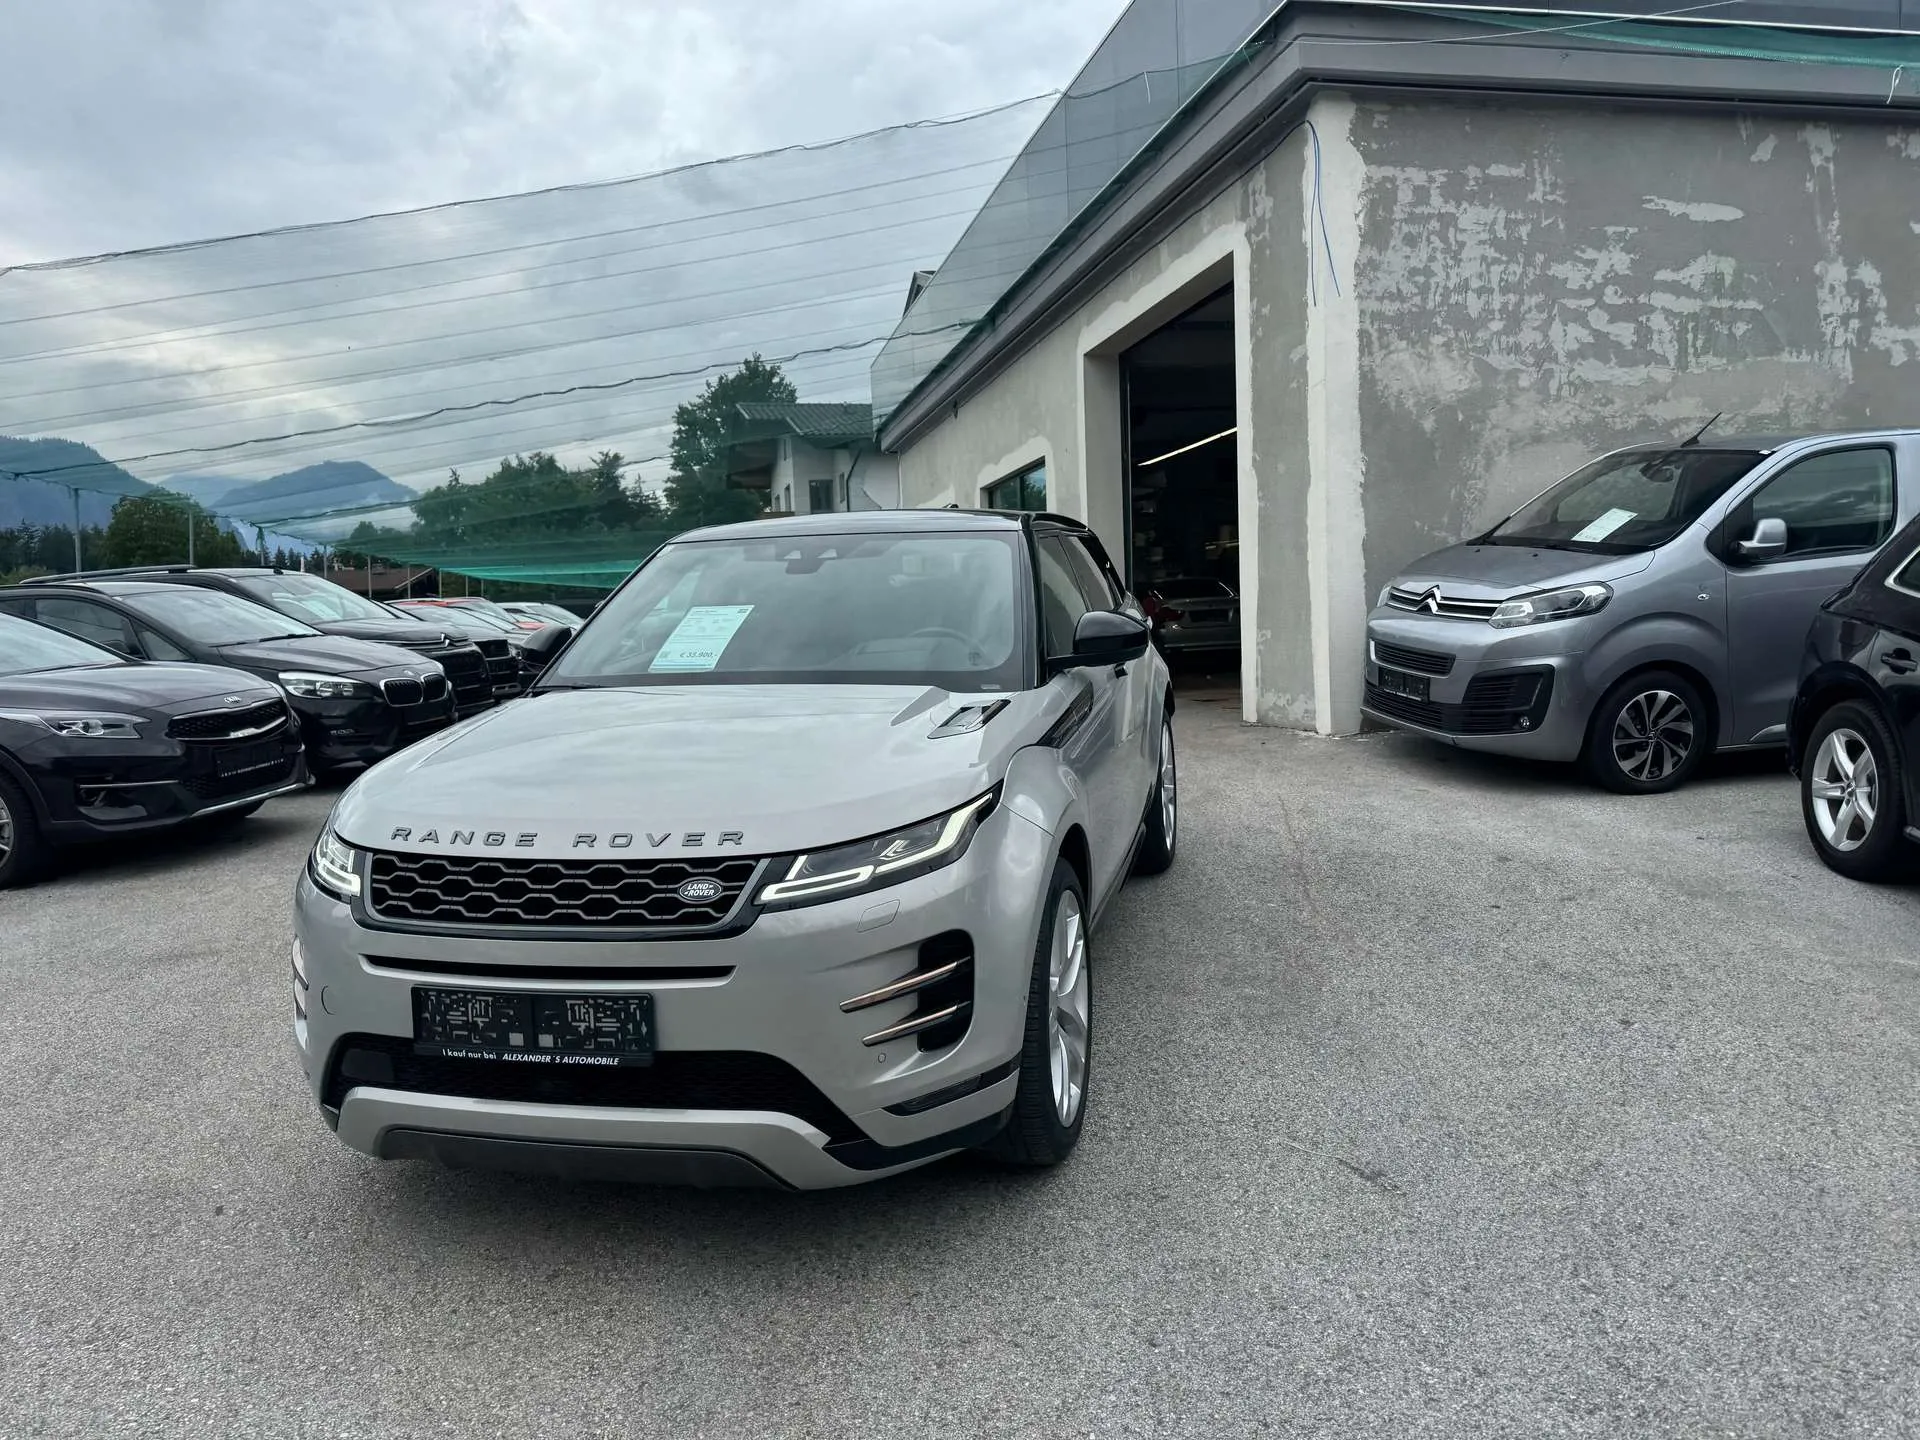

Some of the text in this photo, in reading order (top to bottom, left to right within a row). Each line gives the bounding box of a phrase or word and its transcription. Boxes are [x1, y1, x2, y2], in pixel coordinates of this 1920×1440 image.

[391, 826, 744, 848] RANGE ROVER
[687, 889, 715, 897] ROVER
[447, 1048, 466, 1058] kauf
[483, 1051, 497, 1060] bei
[562, 1056, 620, 1065] AUTOMOBILE
